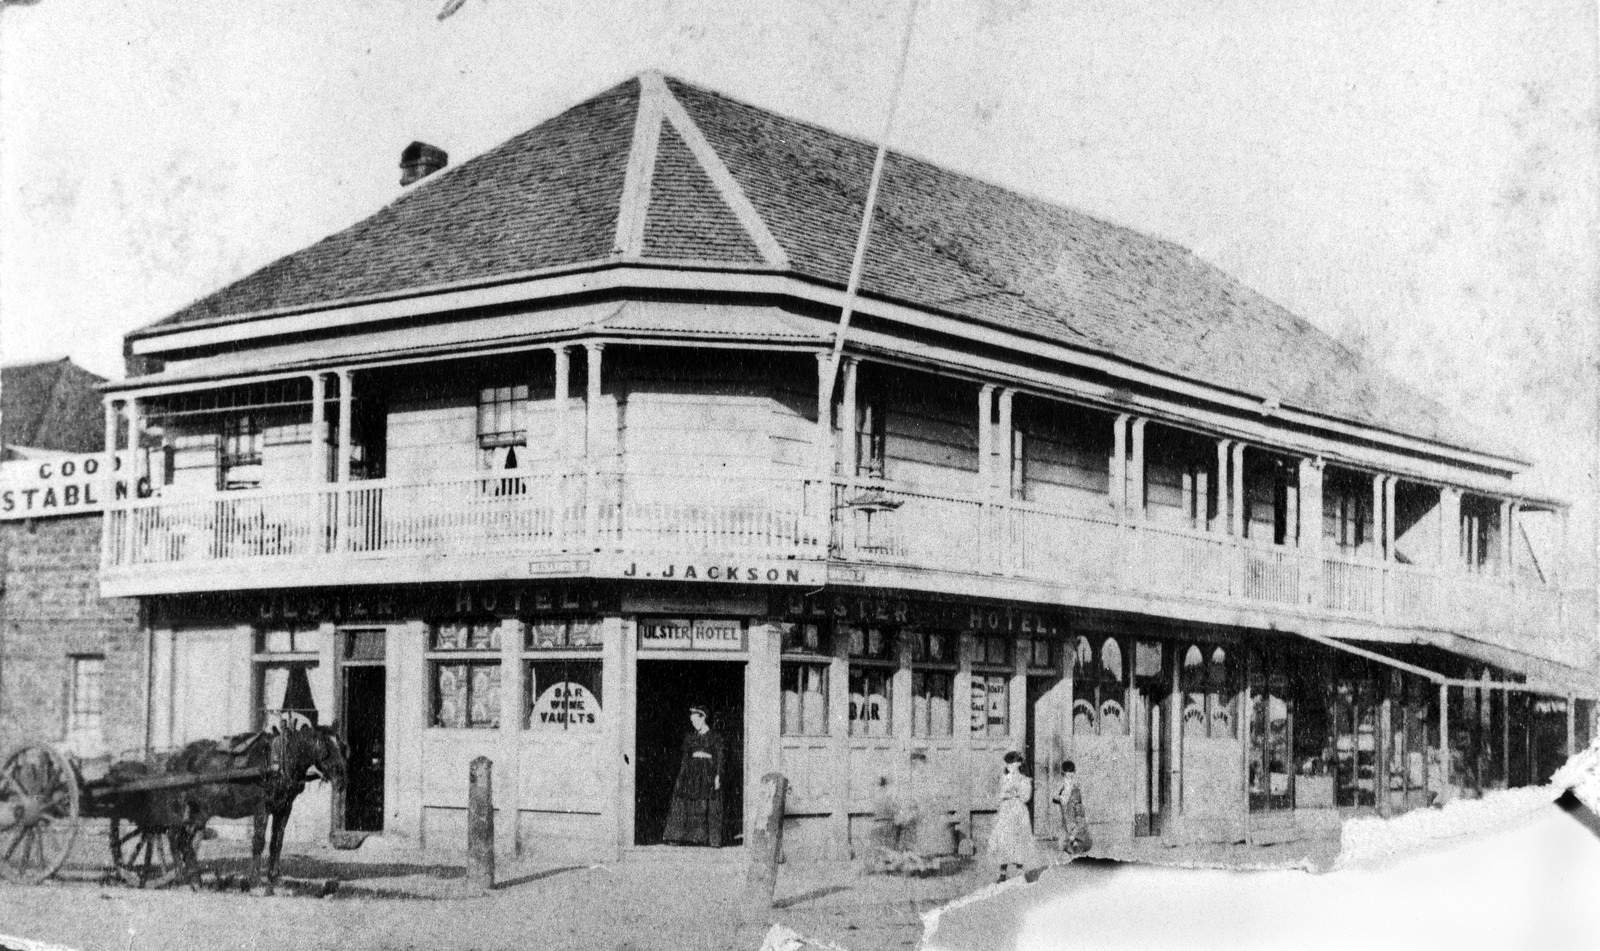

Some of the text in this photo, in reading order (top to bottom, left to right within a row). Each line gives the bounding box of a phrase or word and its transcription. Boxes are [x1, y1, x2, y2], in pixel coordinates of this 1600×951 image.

[3, 477, 161, 511] STABLNG.
[643, 624, 738, 640] ULSTER HOTEL
[554, 688, 583, 698] BAR
[551, 701, 585, 710] WINE
[849, 702, 880, 720] BAR
[541, 712, 595, 723] VAULTS
